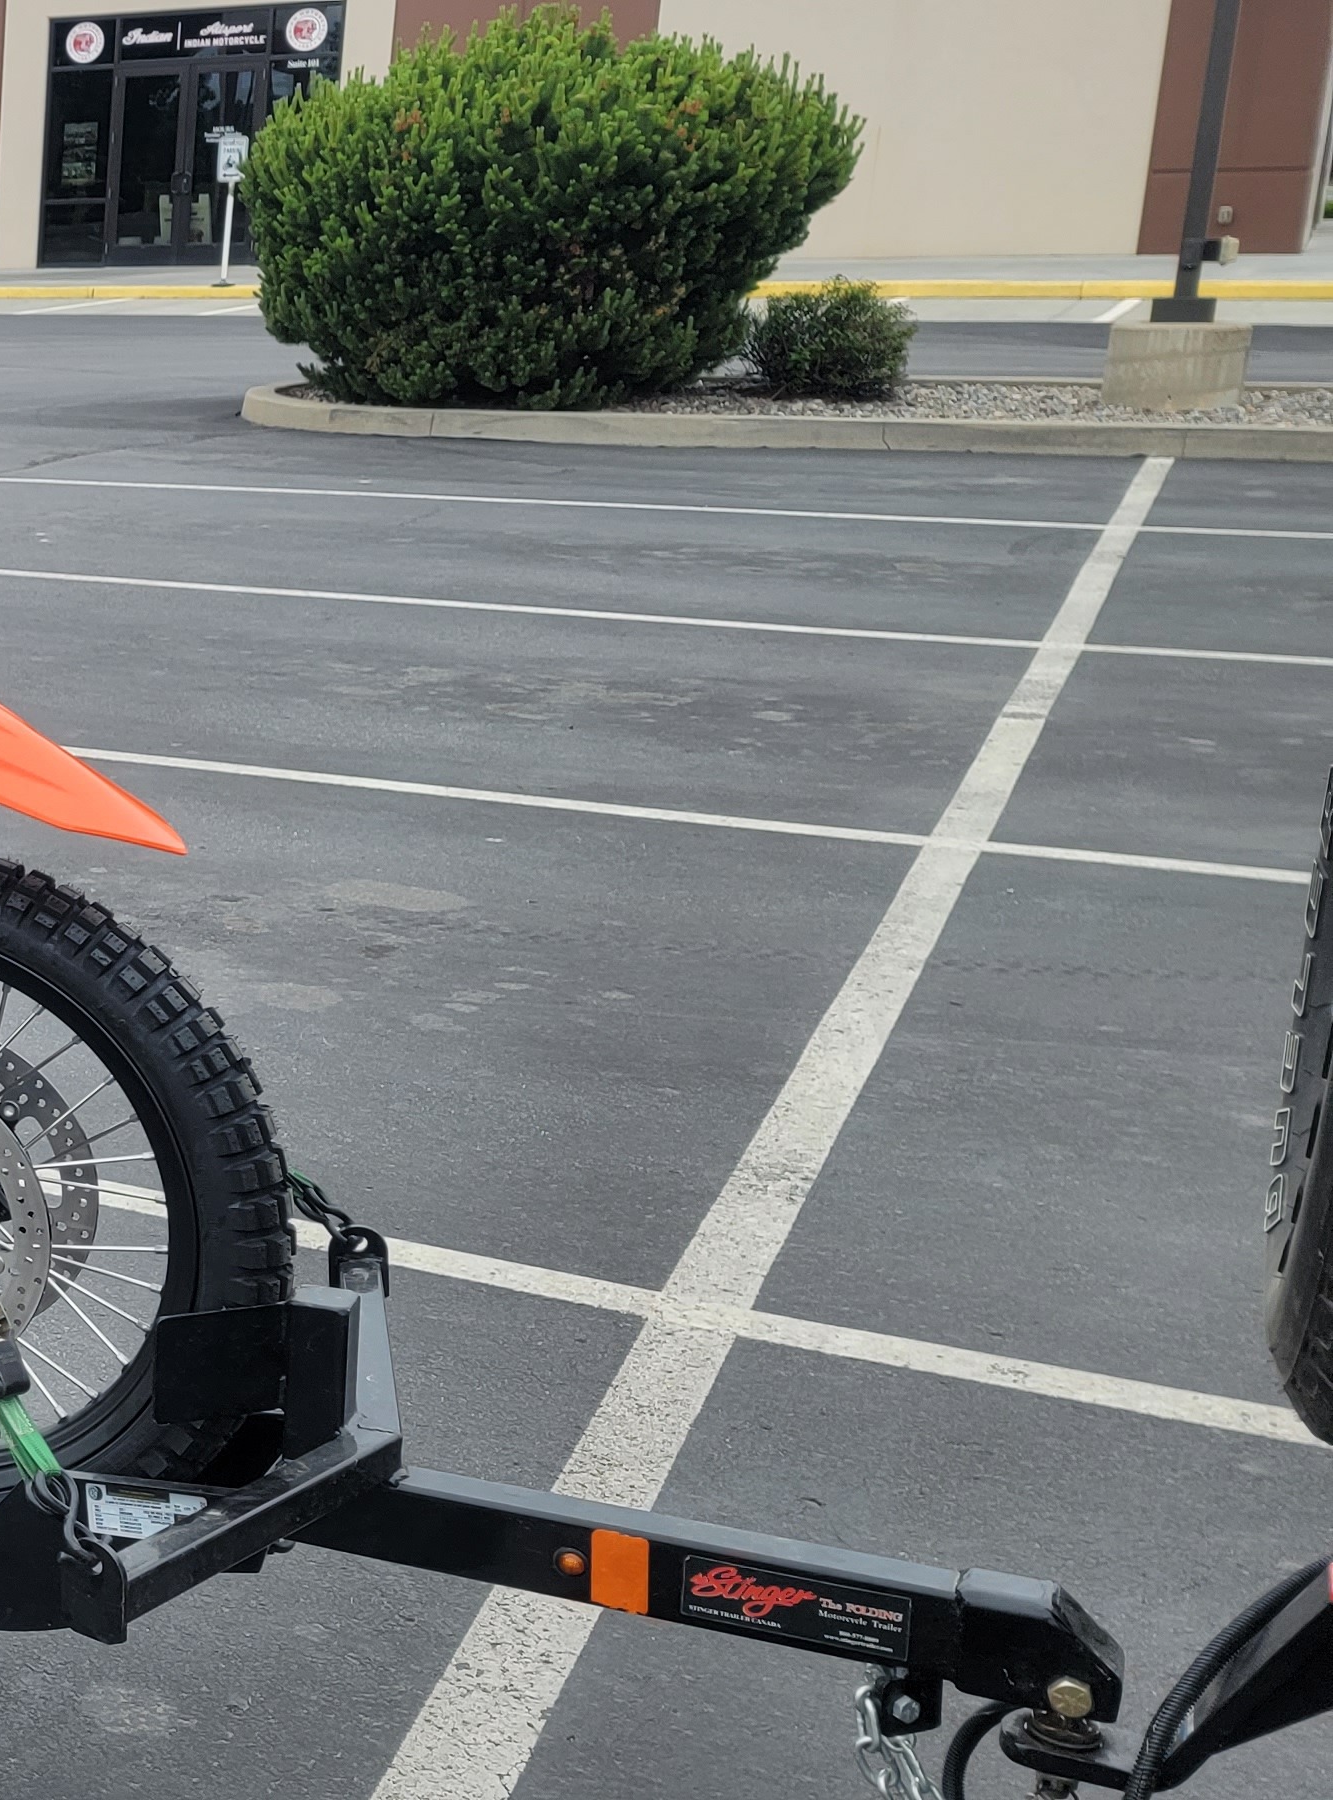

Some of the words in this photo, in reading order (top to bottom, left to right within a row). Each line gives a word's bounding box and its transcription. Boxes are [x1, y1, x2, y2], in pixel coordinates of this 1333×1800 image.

[122, 27, 173, 45] Indian
[184, 37, 211, 48] INDIAN
[213, 35, 266, 47] MOTORCYCLE
[689, 1566, 818, 1618] Stinger
[688, 1604, 719, 1616] STINGER
[720, 1610, 751, 1622] TRAILER
[751, 1616, 782, 1629] CANADA
[818, 1609, 868, 1627] Motorcycle
[871, 1619, 903, 1633] Trailer
[819, 1597, 843, 1611] The
[845, 1602, 904, 1623] FOLDING
